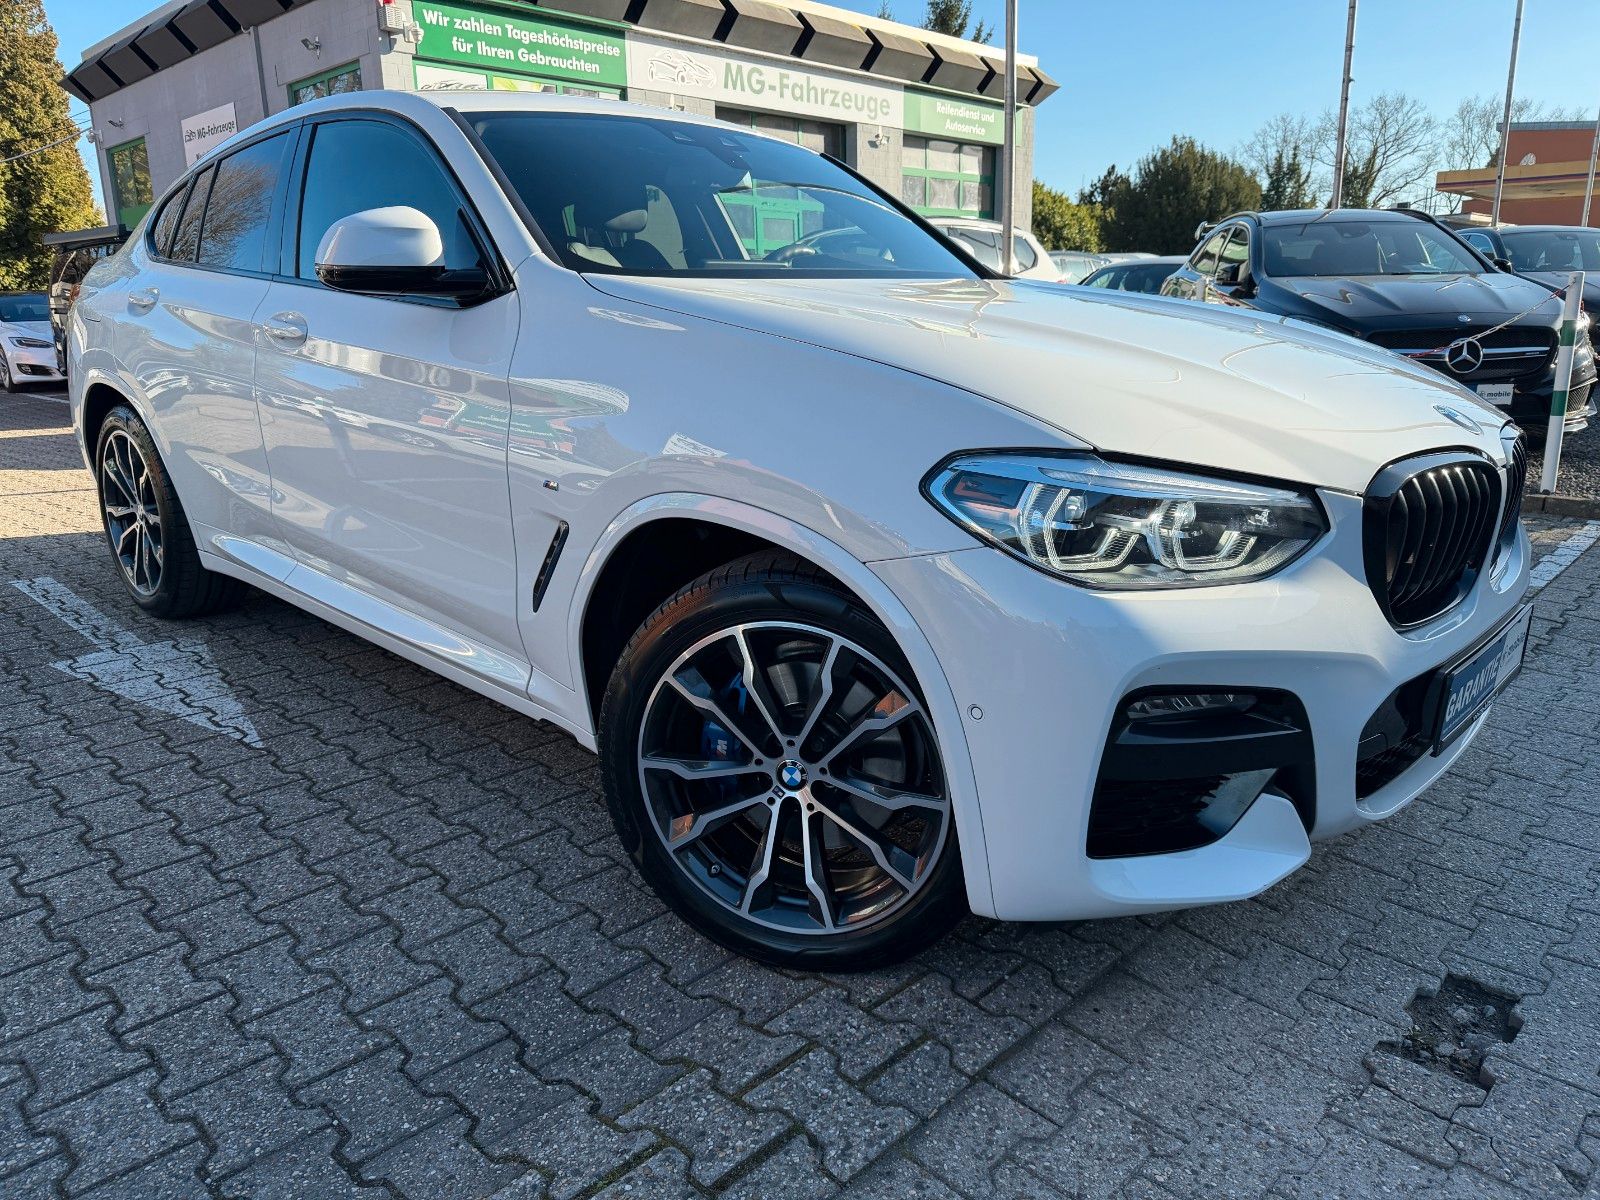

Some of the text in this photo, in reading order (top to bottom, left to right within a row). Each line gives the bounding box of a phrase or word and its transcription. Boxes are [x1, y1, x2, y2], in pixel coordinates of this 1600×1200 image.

[422, 9, 621, 56] Wir zahlen Tageshöchstpreise
[452, 36, 600, 74] für Ihren Gebrauchten
[723, 62, 890, 120] MG-Fahrzeuge
[936, 101, 995, 123] Reifendienst und
[945, 119, 986, 135] Autoservice
[1445, 651, 1502, 722] GARANTIE
